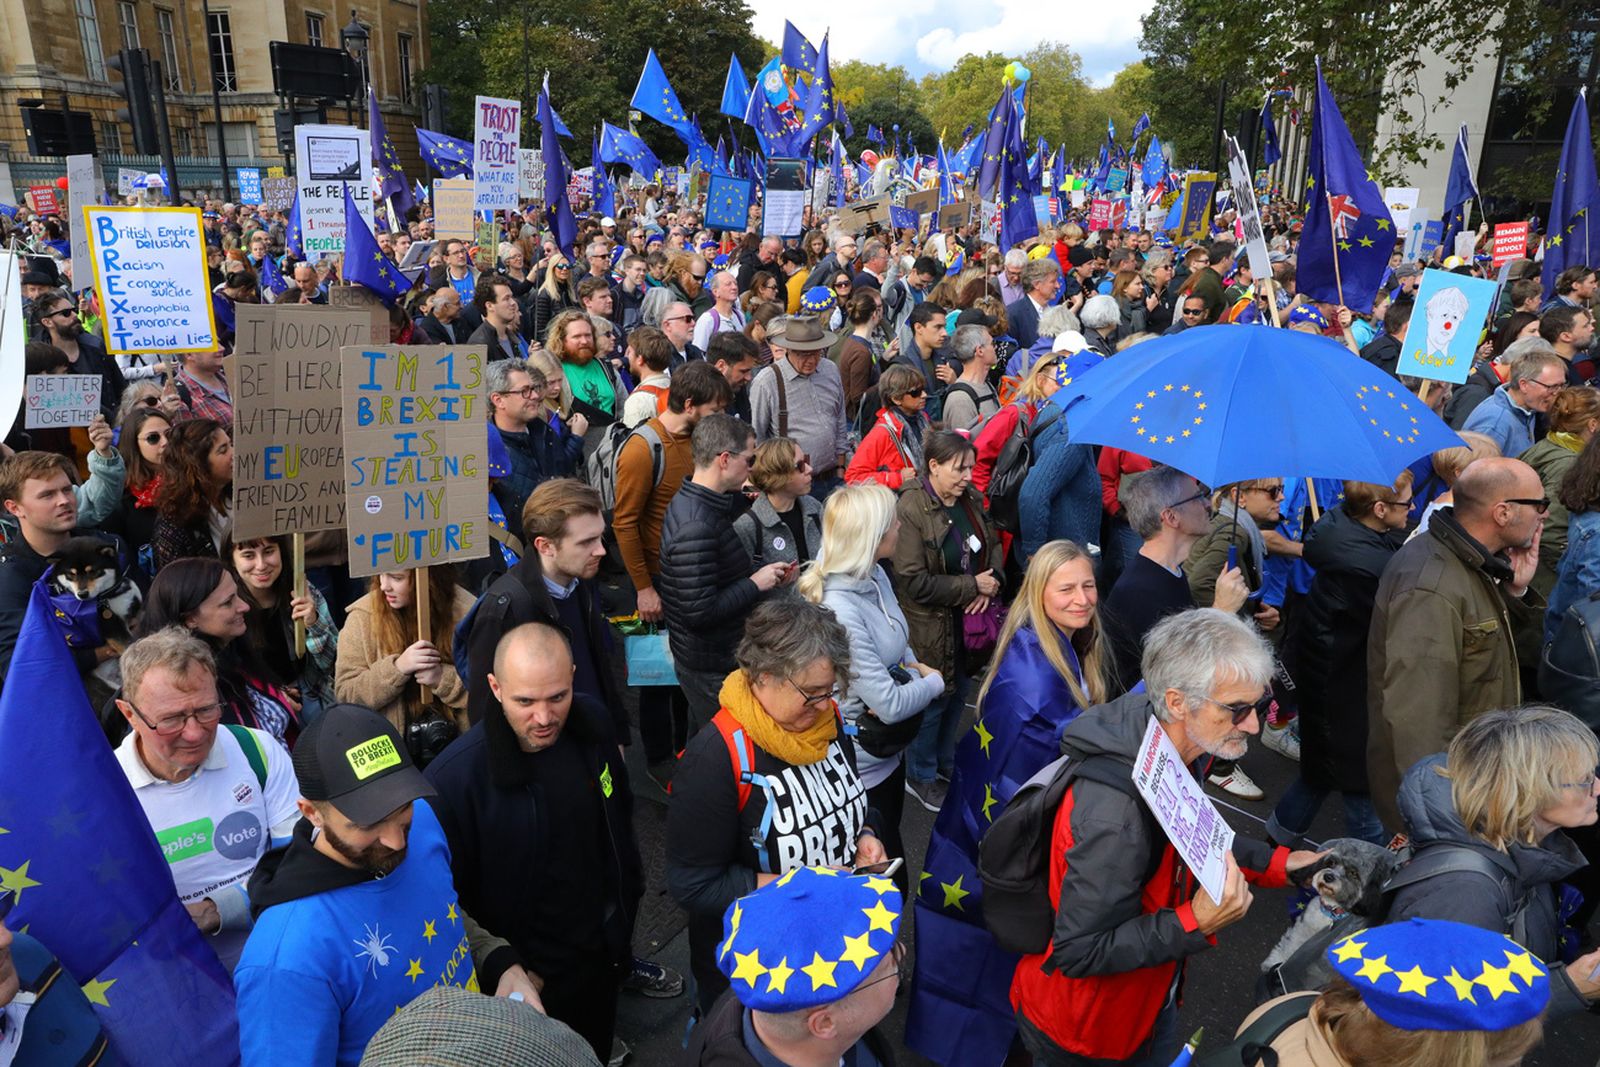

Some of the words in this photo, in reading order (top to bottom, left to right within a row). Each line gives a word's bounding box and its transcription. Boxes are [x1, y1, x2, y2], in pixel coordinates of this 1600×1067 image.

[480, 103, 519, 134] TRUST
[492, 132, 503, 141] THE
[480, 139, 517, 164] PEOPLE
[522, 152, 533, 161] WE
[478, 171, 500, 182] WHAT
[502, 173, 515, 184] ARE
[523, 169, 543, 179] PEOP
[302, 186, 322, 199] THE
[476, 194, 504, 205] AFRAID
[490, 185, 504, 193] YOU
[306, 207, 334, 215] deserve
[97, 216, 150, 247] British
[158, 226, 196, 243] Empire
[307, 218, 315, 230] 1
[1496, 227, 1526, 236] REMAIN
[136, 238, 191, 249] Delusion
[1495, 236, 1525, 245] REFORM
[1496, 244, 1524, 253] REVOLT
[103, 249, 165, 272] Racism
[106, 275, 177, 296] Economic
[151, 288, 193, 298] suicide
[332, 287, 376, 305] BREX
[110, 298, 191, 315] Xenophobia
[113, 316, 191, 332] Ignorance
[112, 332, 178, 351] Tabloid
[187, 332, 213, 346] Lies
[245, 320, 265, 355] I
[1413, 348, 1457, 368] CLOWN
[240, 363, 269, 398] BE
[358, 351, 420, 392] I'M
[433, 352, 482, 392] 13
[35, 376, 100, 393] BETTER
[238, 407, 343, 436] WITHOUT
[357, 394, 478, 427] BREXIT
[393, 430, 439, 458] IS
[237, 451, 259, 481] MY
[263, 443, 344, 481] EUROPEA
[350, 454, 478, 487] STEALING
[236, 481, 310, 511] FRIENDS
[403, 487, 446, 521] MY
[274, 502, 346, 532] FAMILY
[371, 521, 474, 568] FUTURE
[351, 738, 391, 761] BOLLOCKS
[353, 757, 366, 769] TO
[367, 746, 395, 762] BREXIT
[1142, 725, 1163, 776] MARCHING
[766, 740, 865, 834] CANCEL
[1138, 771, 1148, 790] I'M
[1155, 779, 1178, 825] EU
[161, 832, 207, 858] ple's
[221, 827, 258, 847] Vote
[1187, 797, 1215, 874] EVERYTHING
[180, 894, 192, 902] te
[192, 890, 204, 898] on
[204, 883, 219, 894] the
[440, 936, 470, 987] LOCKS
